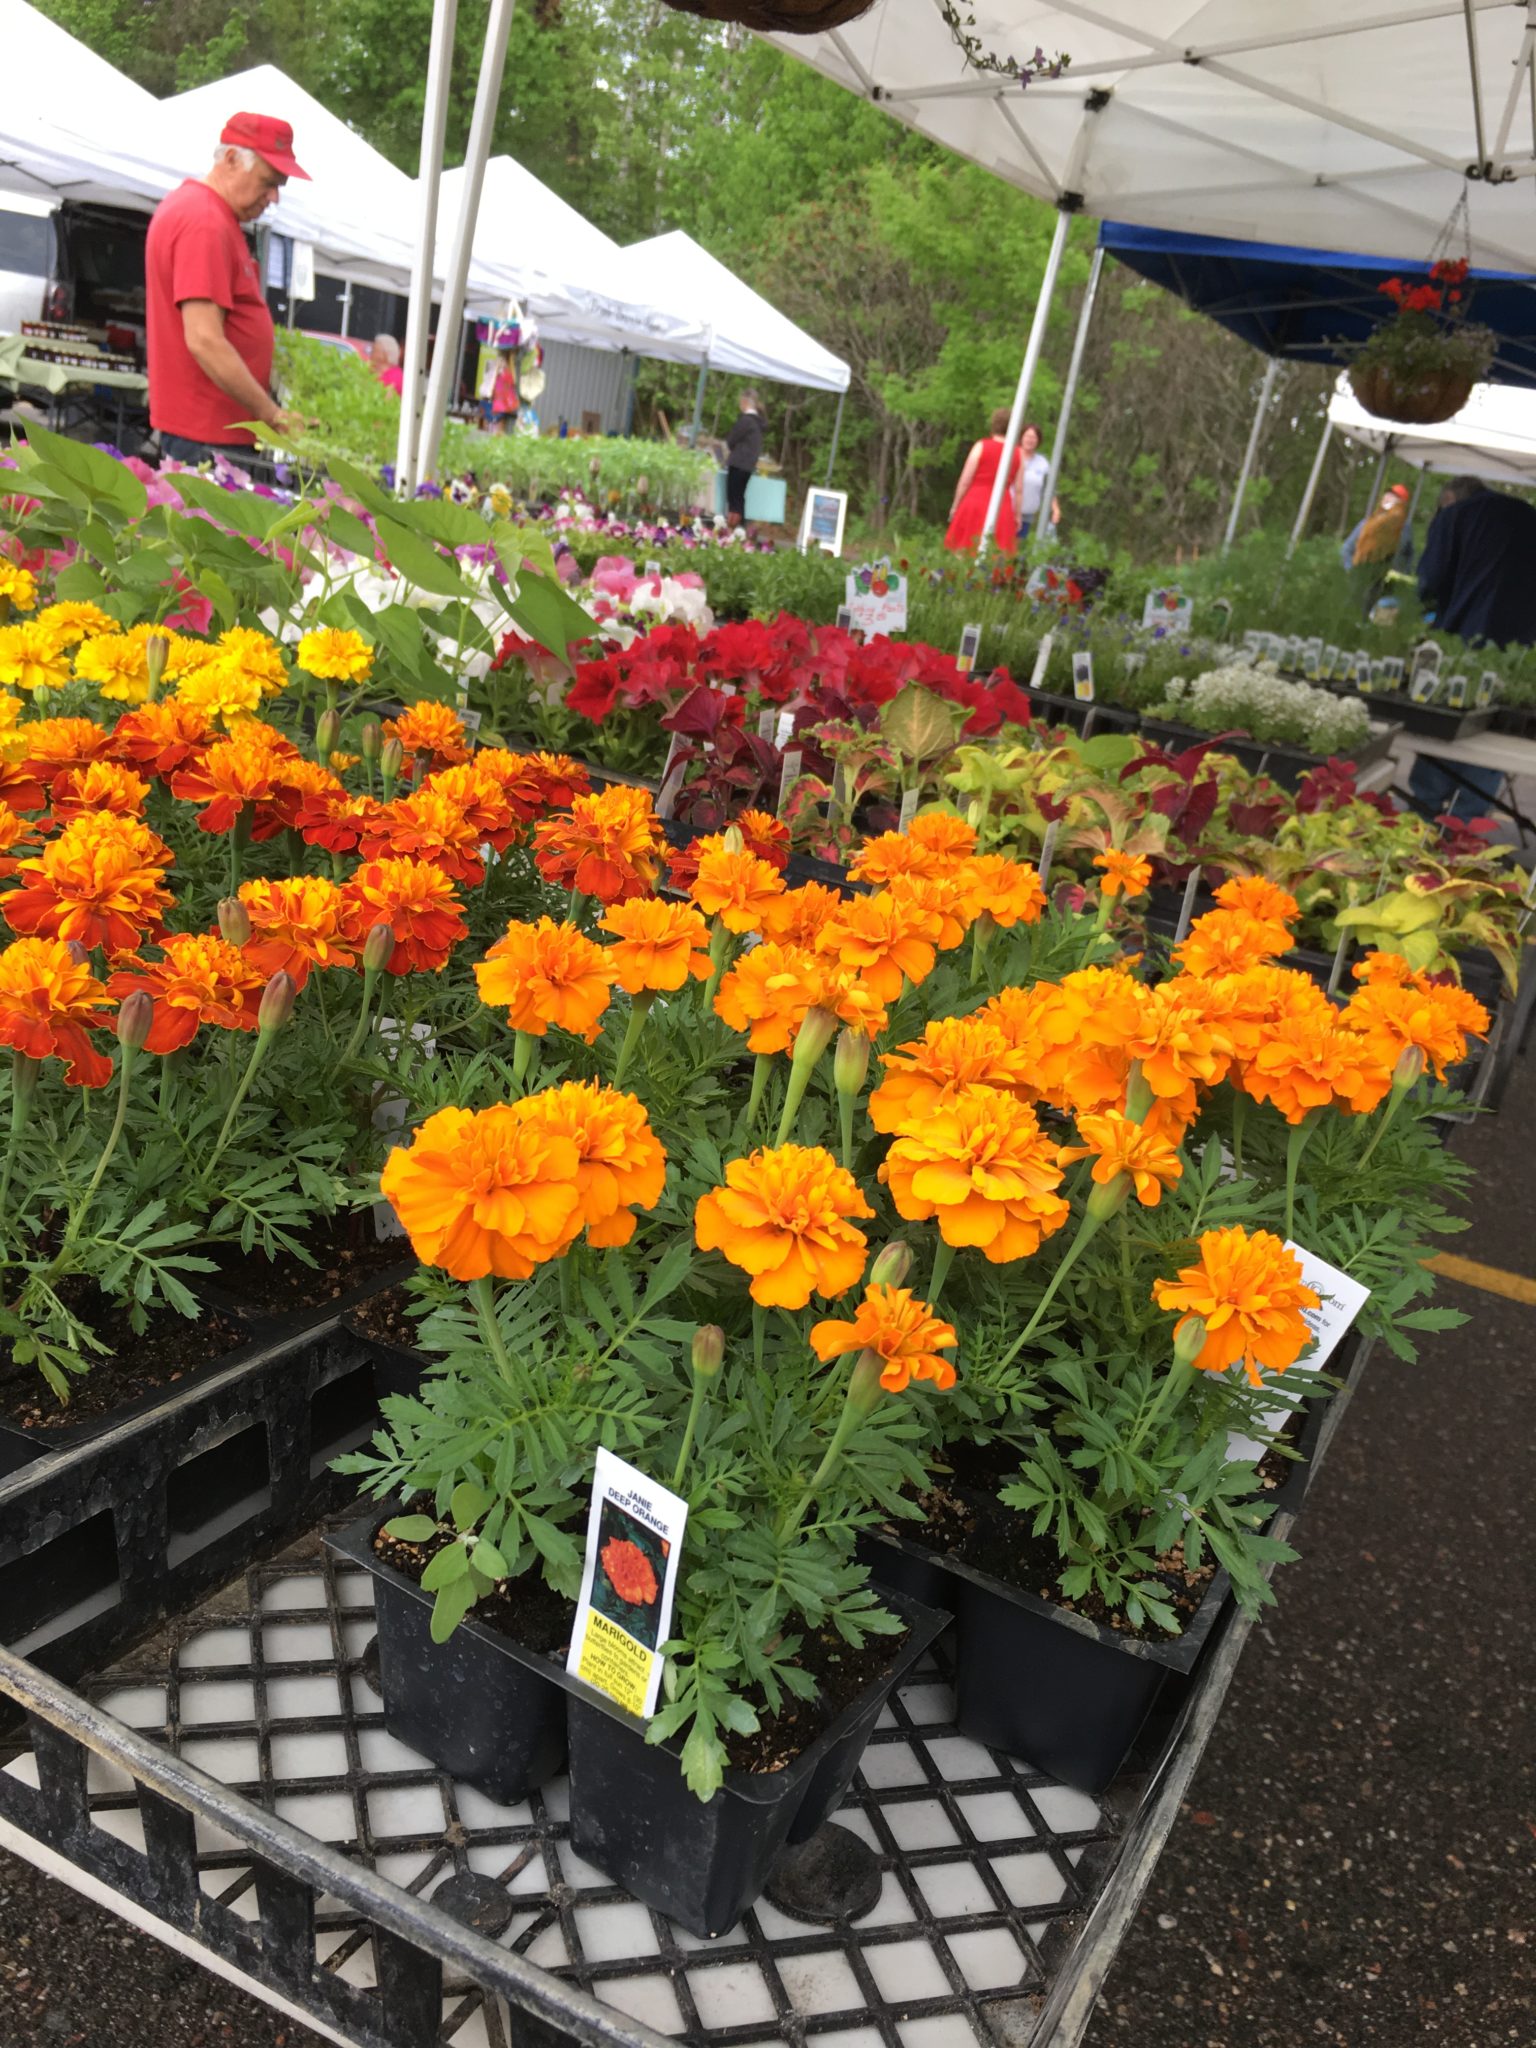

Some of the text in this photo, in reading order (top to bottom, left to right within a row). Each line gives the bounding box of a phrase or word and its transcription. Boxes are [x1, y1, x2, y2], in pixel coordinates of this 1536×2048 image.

[608, 1487, 669, 1535] DEEP ORANGE
[627, 1490, 653, 1512] JANIE
[591, 1628, 607, 1643] Large
[608, 1640, 627, 1659] blooms
[593, 1615, 647, 1662] MARIGOLD
[590, 1653, 606, 1667] HOW
[607, 1663, 616, 1674] TO
